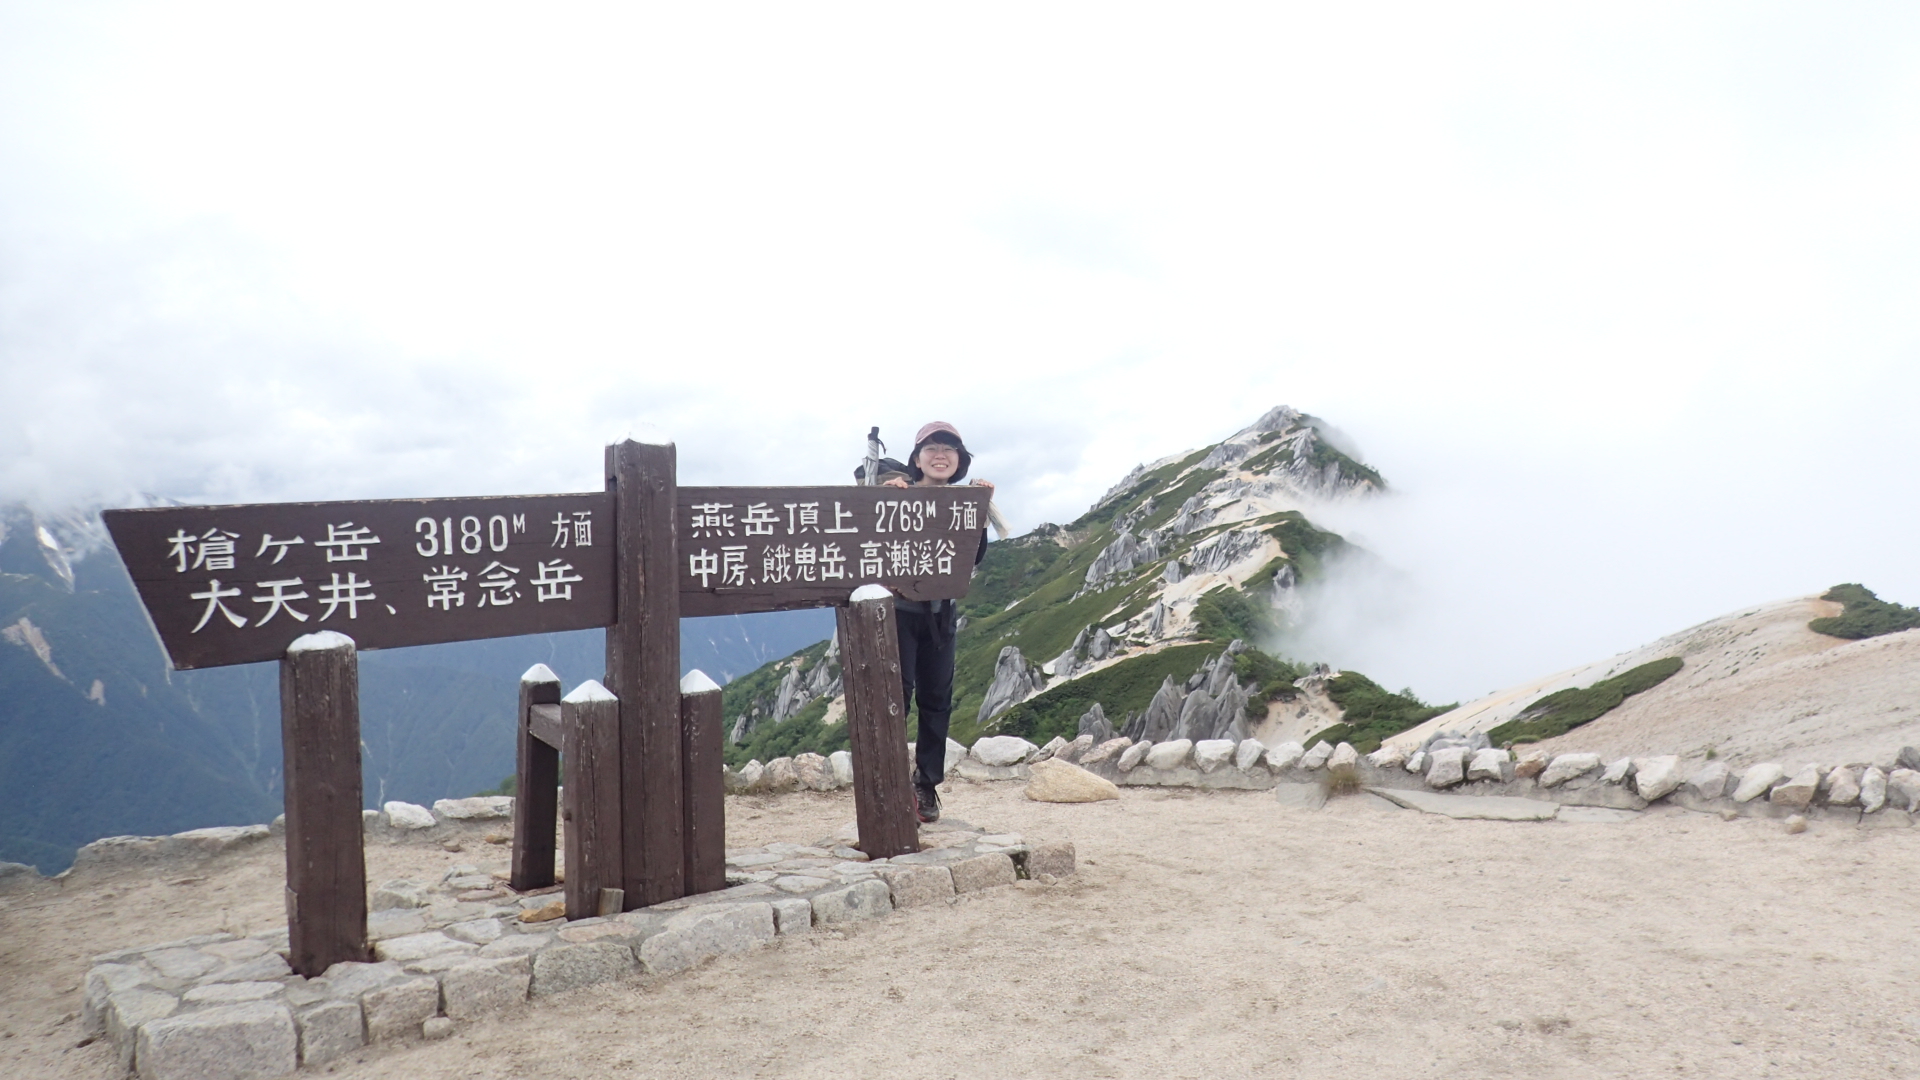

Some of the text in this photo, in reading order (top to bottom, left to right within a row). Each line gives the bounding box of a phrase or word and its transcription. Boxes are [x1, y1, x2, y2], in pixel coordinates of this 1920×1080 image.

[551, 511, 592, 549] 方面
[690, 501, 859, 539] 燕岳頂上
[948, 500, 978, 533] 方面
